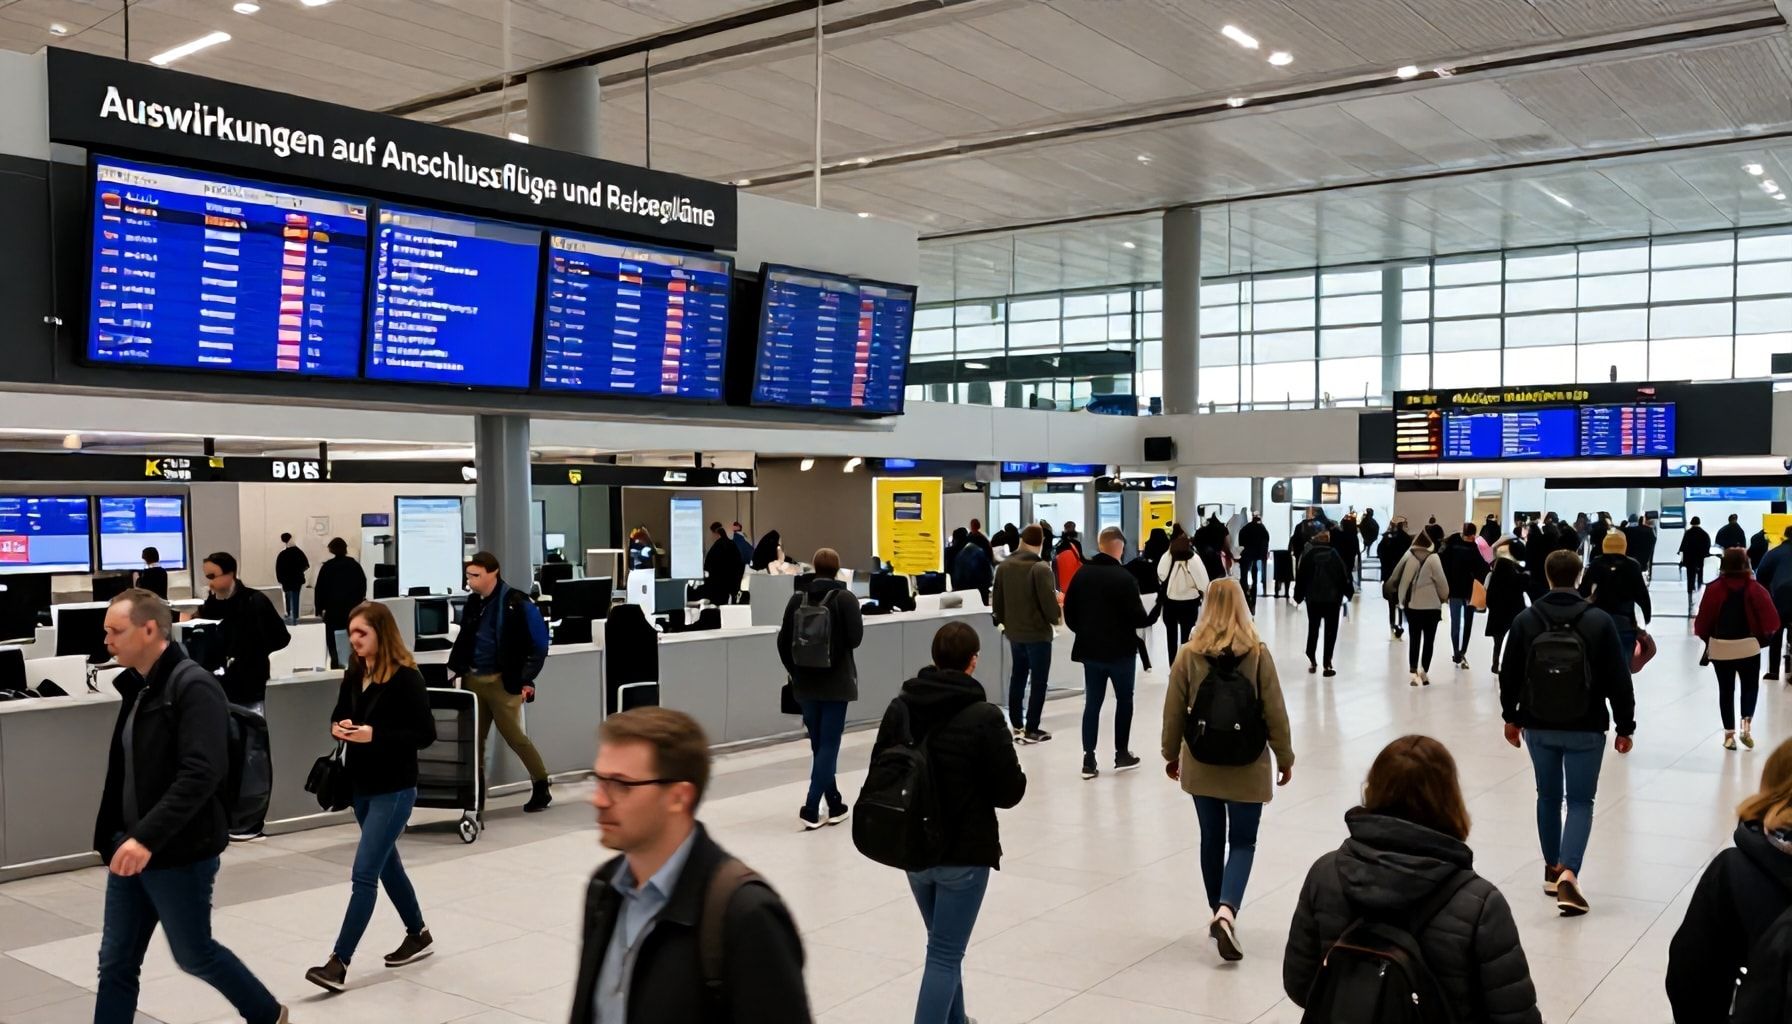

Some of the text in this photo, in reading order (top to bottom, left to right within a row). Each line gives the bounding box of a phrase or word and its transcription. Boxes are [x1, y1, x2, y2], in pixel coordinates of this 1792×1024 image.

[100, 86, 325, 158] Auswirkungen
[331, 136, 376, 166] auf
[562, 181, 602, 207] und
